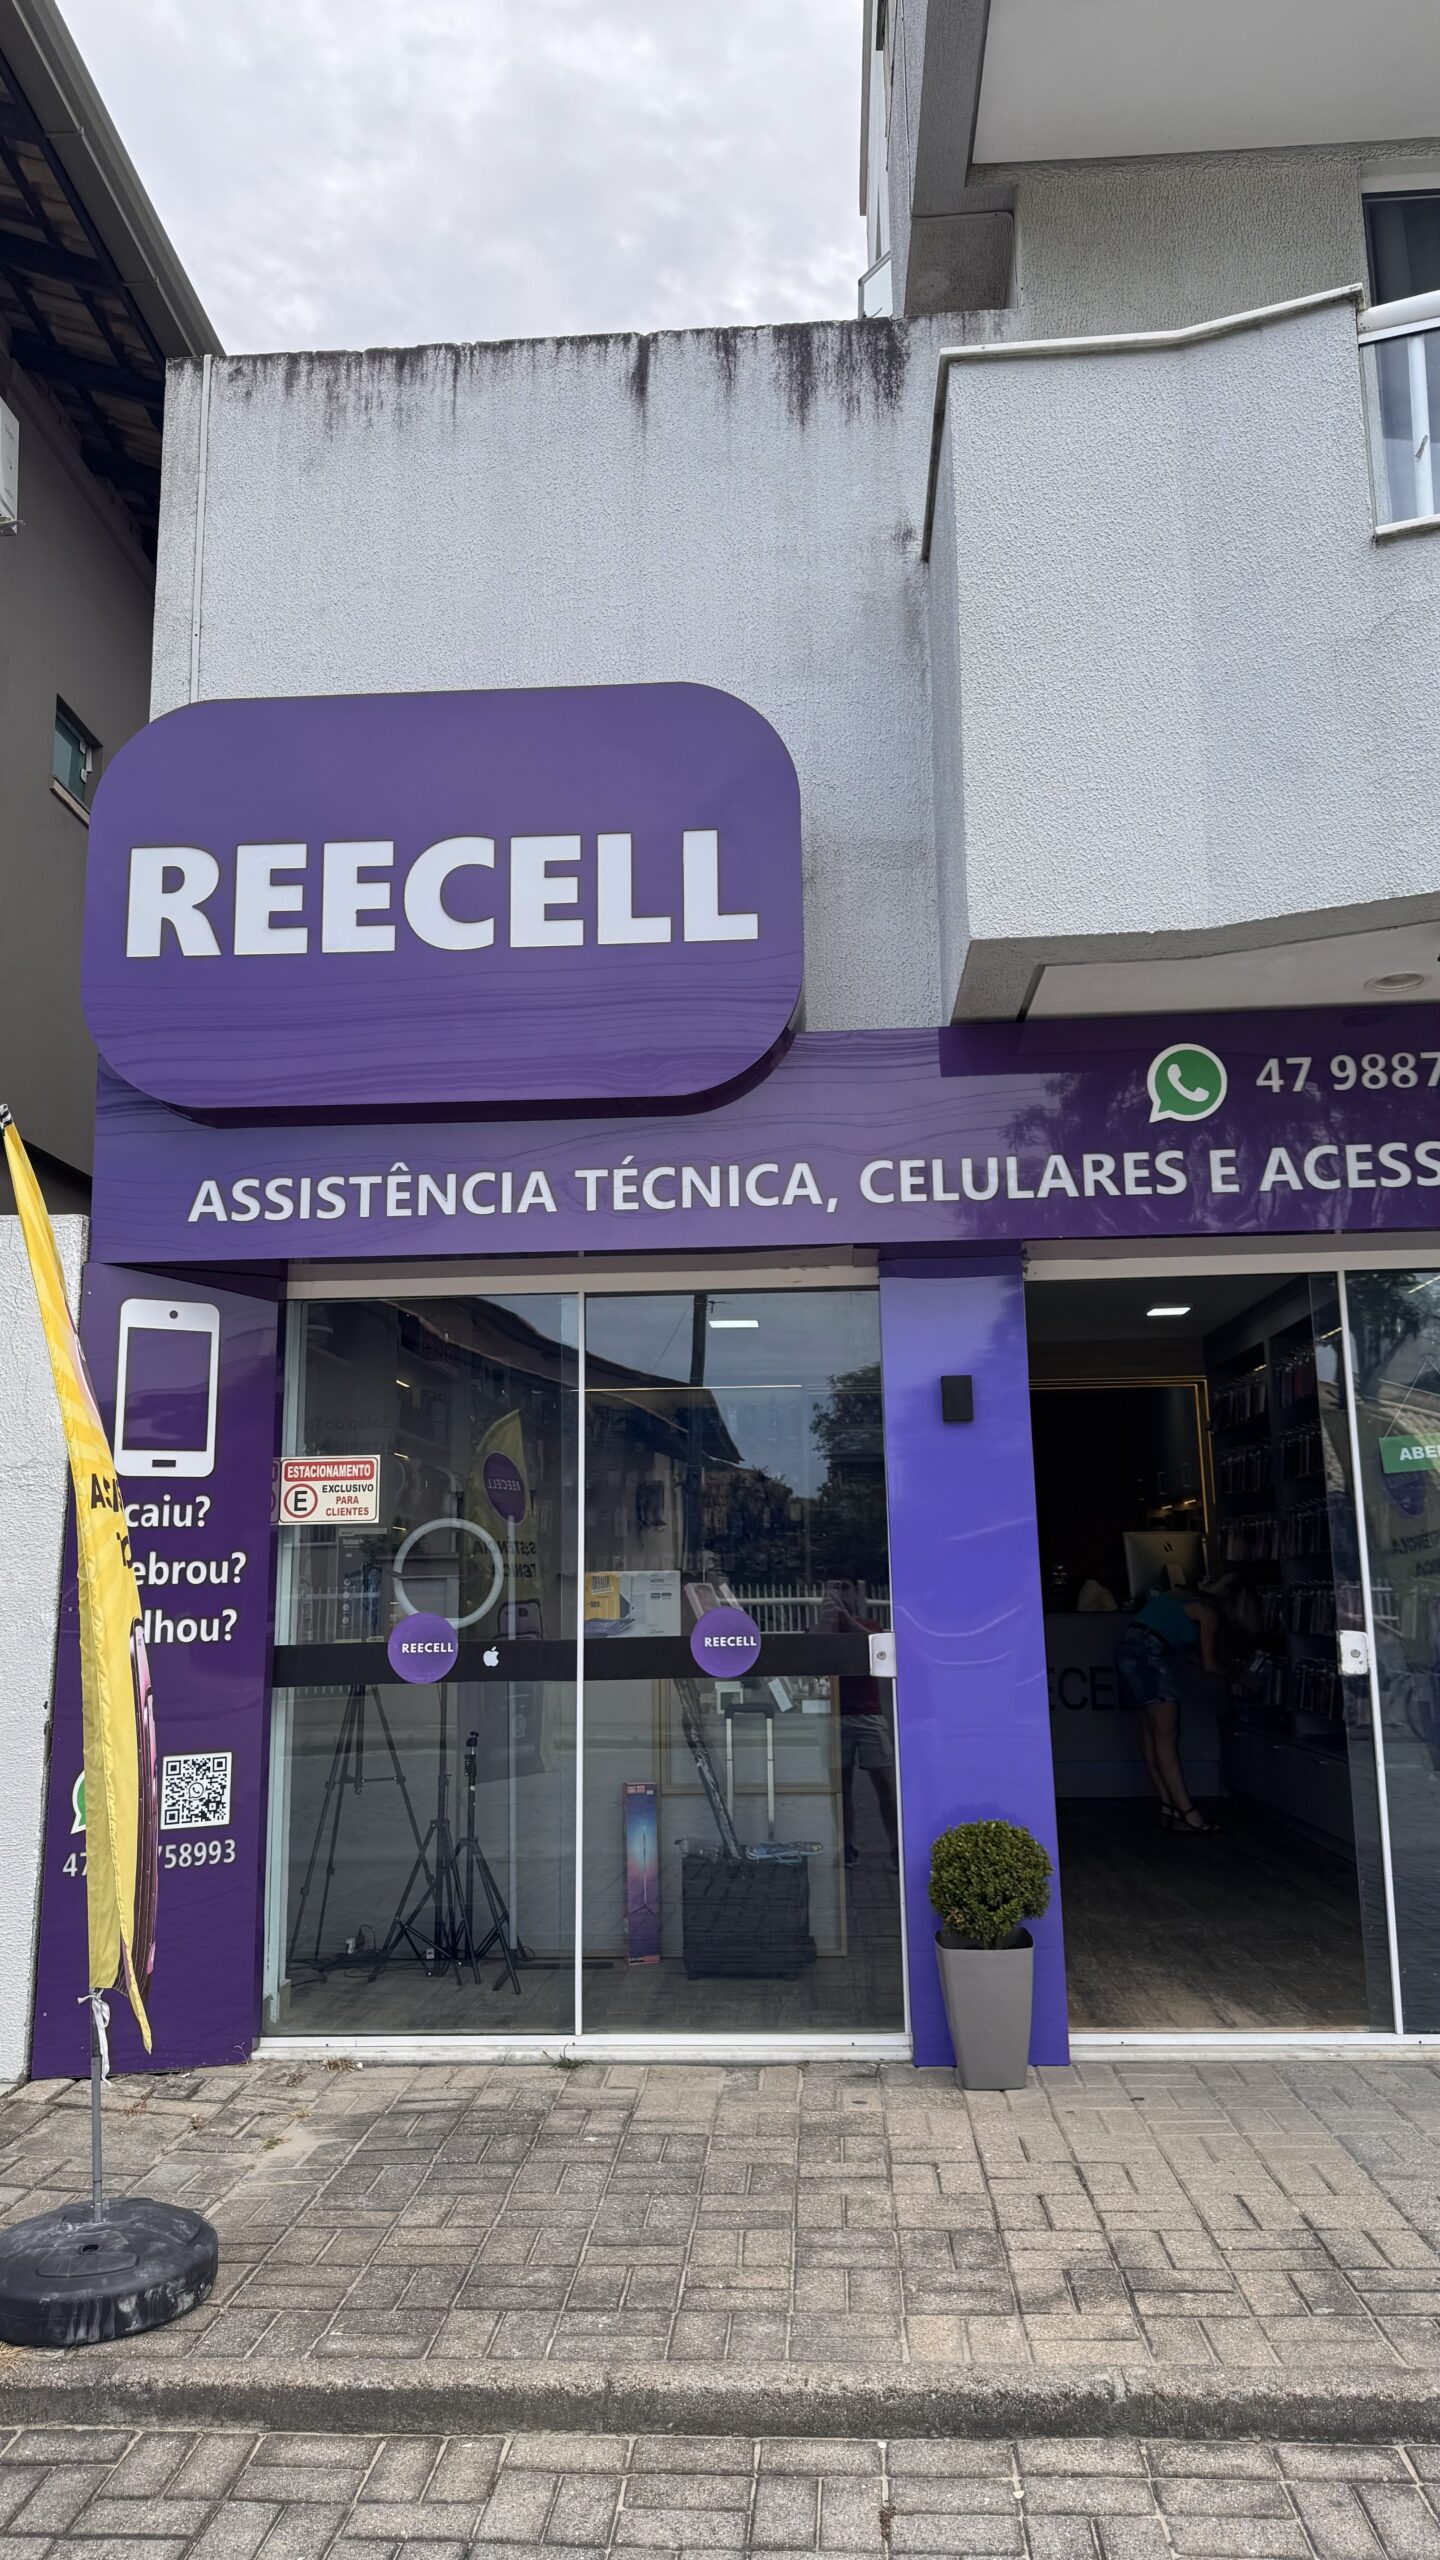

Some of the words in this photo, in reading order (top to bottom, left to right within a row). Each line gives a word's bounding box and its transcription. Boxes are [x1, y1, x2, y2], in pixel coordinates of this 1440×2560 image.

[126, 829, 760, 958] REECELL
[1256, 1057, 1312, 1093] 47
[187, 1161, 558, 1223] ASSISTÊNCIA
[574, 1154, 839, 1213] TÉCNICA,
[859, 1150, 1187, 1204] CELULARES
[1209, 1149, 1240, 1193] E
[1259, 1141, 1440, 1192] ACESS
[1400, 1445, 1440, 1461] ABE
[287, 1464, 371, 1479] ESTACIONAMENTO
[322, 1483, 374, 1493] EXCLUSIVO
[125, 1493, 211, 1528] caiu?
[293, 1490, 308, 1512] E
[335, 1495, 359, 1505] PARA
[325, 1506, 369, 1517] CLIENTES
[132, 1551, 247, 1586] ebrou?
[143, 1608, 238, 1644] lhou?
[401, 1642, 454, 1654] REECELL
[704, 1636, 757, 1647] REECELL
[158, 1838, 236, 1869] 58993
